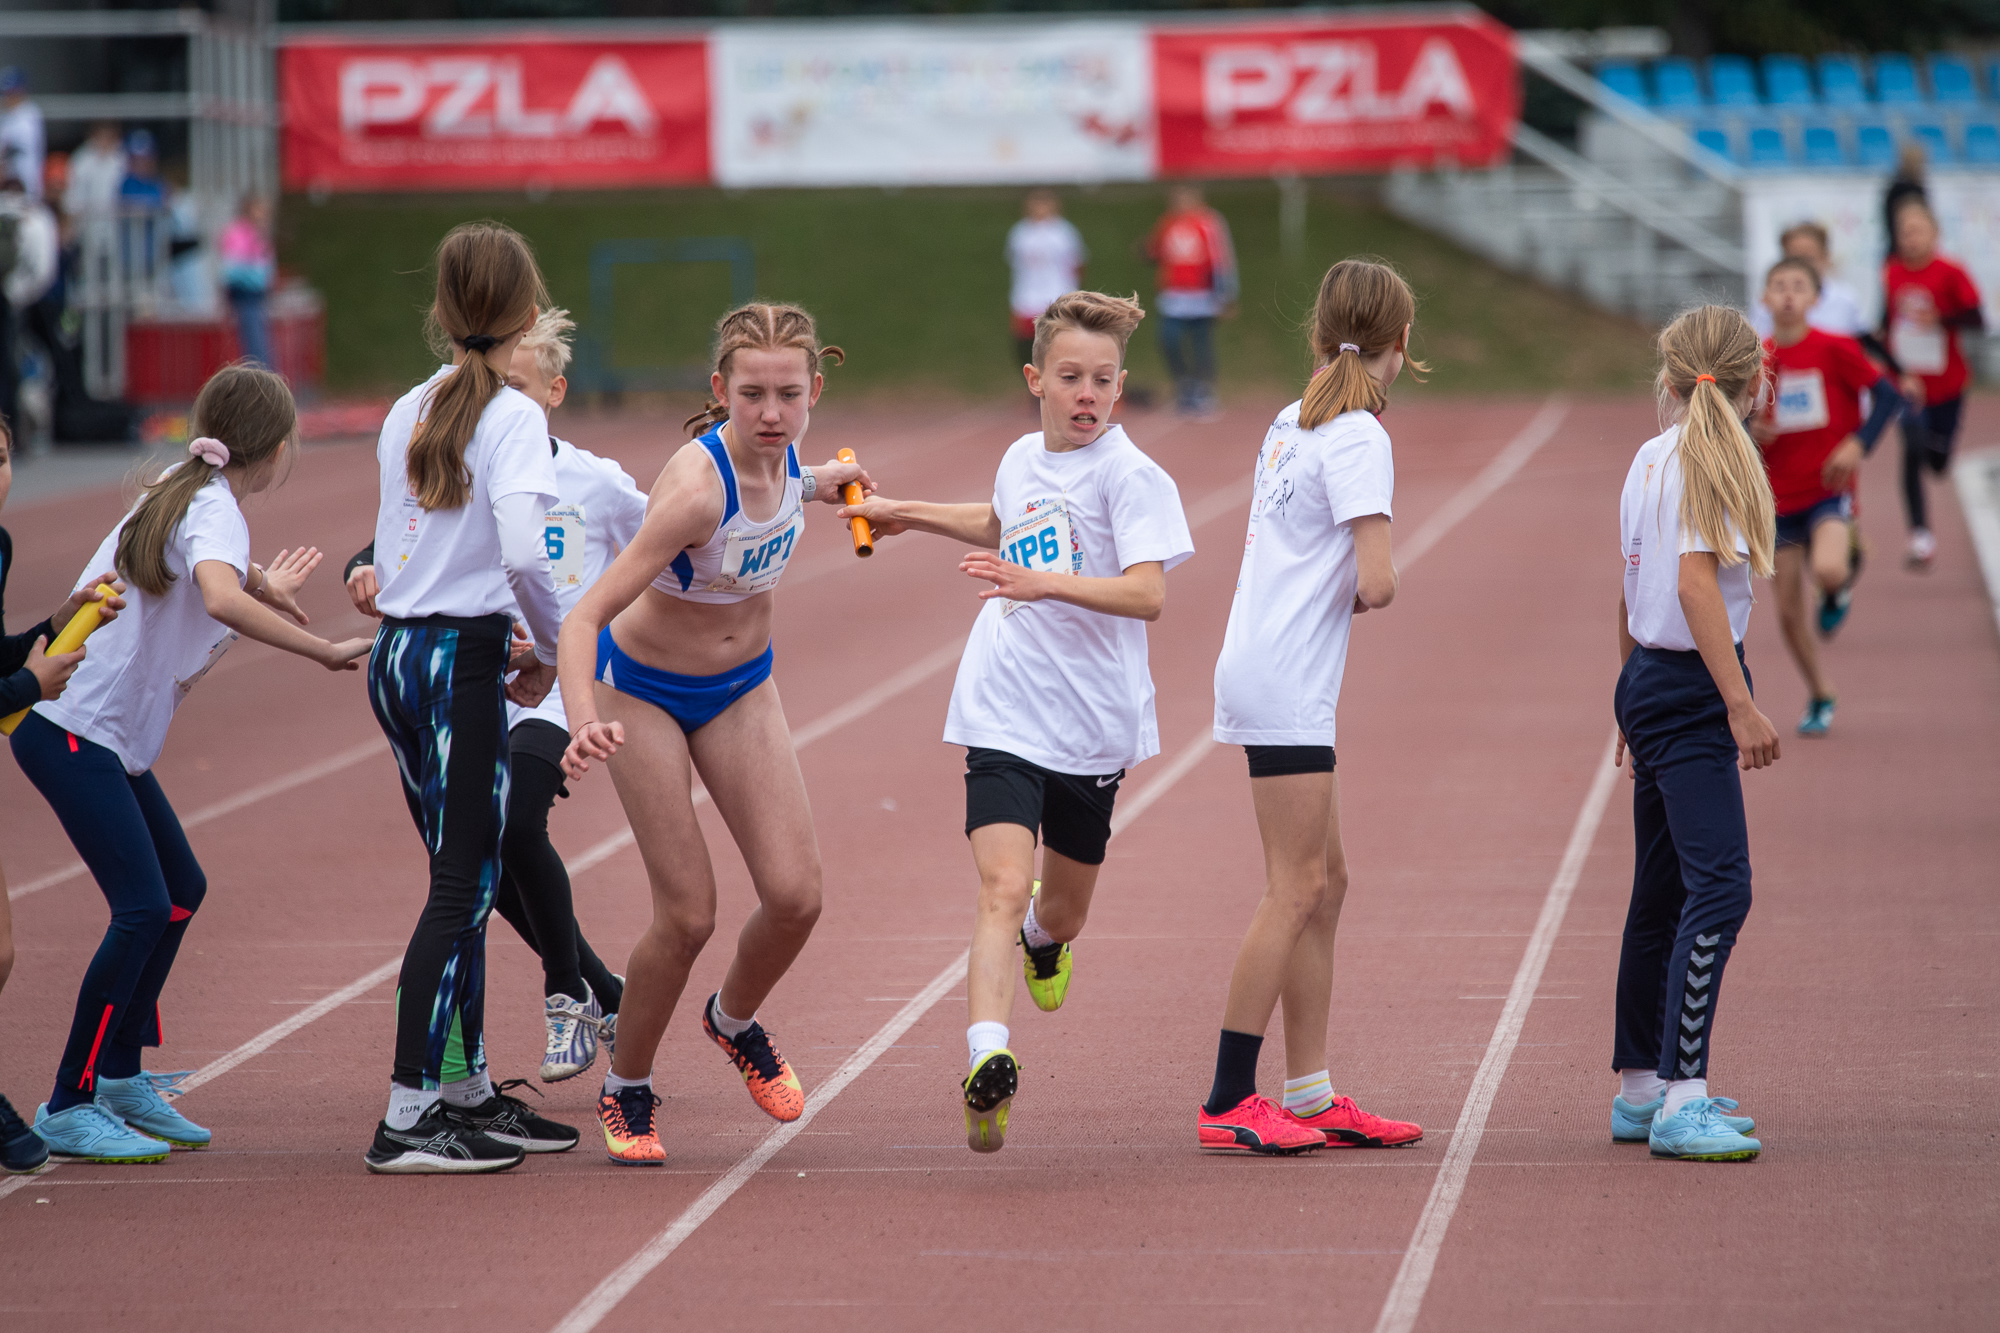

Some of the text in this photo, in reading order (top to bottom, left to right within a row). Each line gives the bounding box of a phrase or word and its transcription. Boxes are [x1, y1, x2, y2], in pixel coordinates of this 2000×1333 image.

[338, 53, 658, 138] PZLA
[1202, 36, 1476, 126] PZLA
[737, 525, 795, 578] WP7
